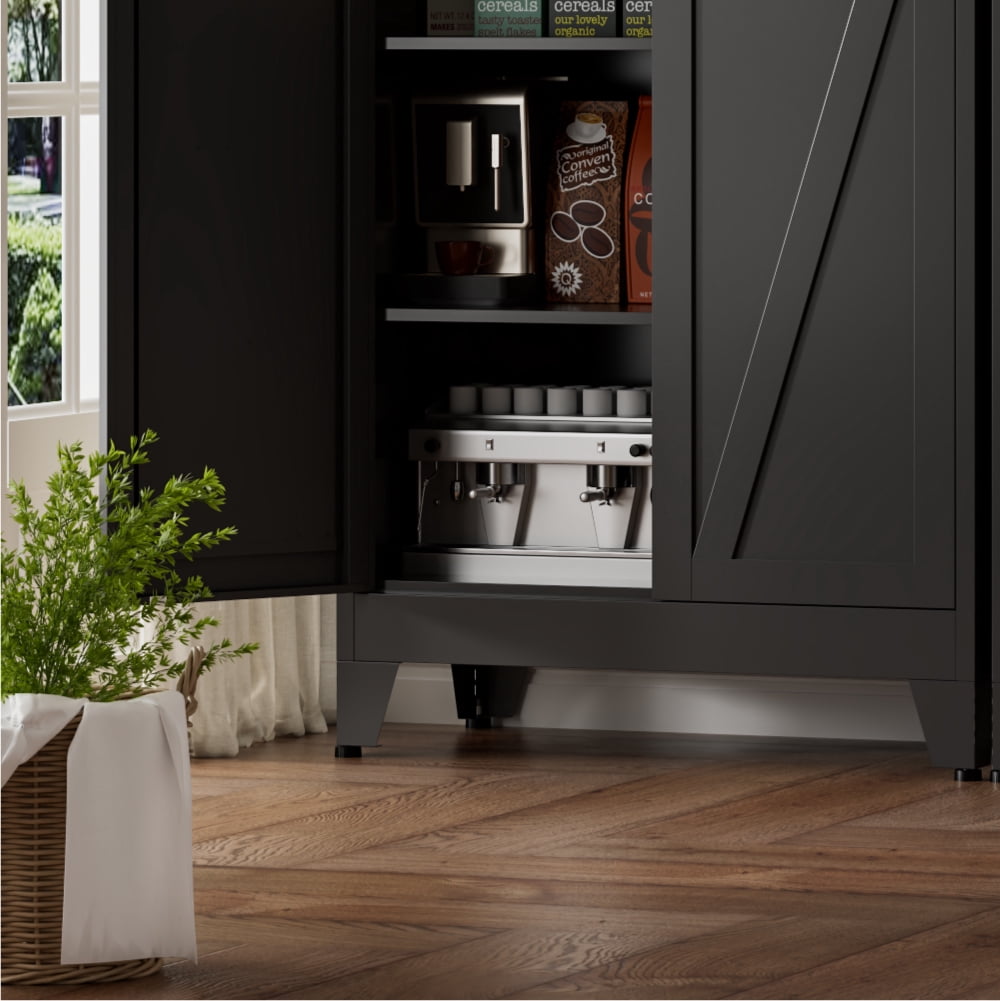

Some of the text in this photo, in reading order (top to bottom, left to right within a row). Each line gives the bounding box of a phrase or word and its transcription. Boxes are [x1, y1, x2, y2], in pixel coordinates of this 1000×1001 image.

[555, 15, 608, 26] our lovely
[626, 16, 646, 24] our
[555, 27, 596, 37] organic
[576, 141, 609, 158] original
[562, 154, 610, 174] Conven
[563, 168, 597, 184] coffee
[562, 272, 572, 286] Q
